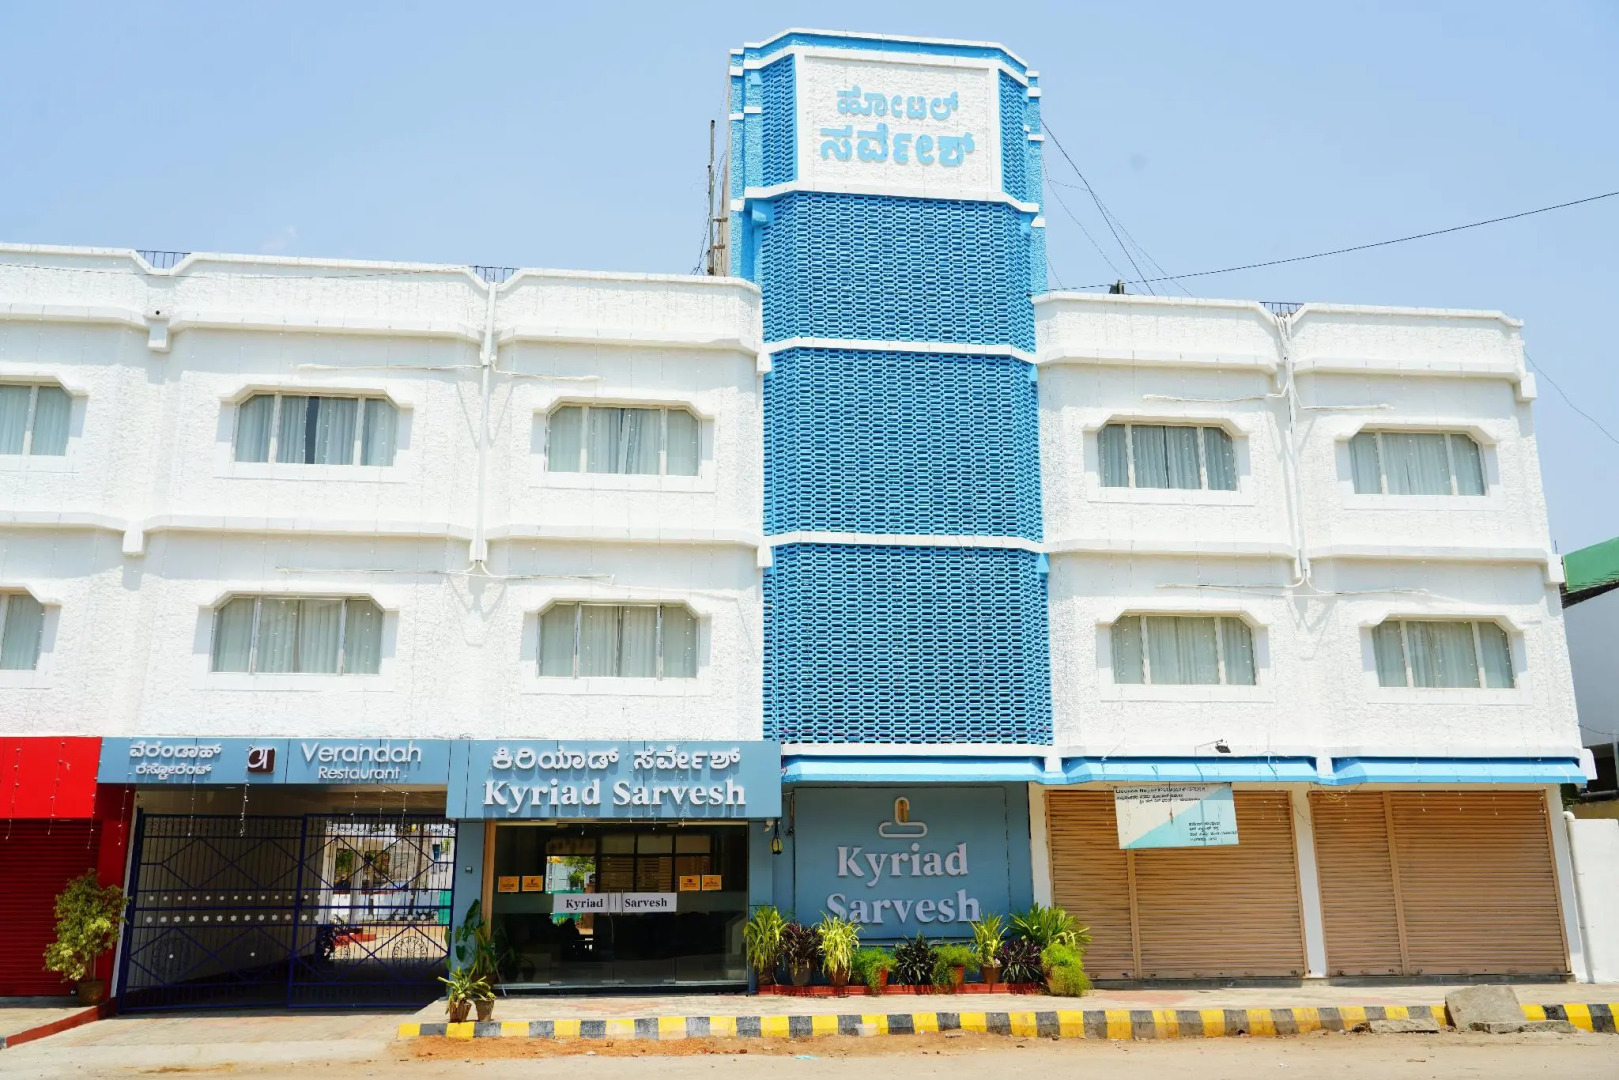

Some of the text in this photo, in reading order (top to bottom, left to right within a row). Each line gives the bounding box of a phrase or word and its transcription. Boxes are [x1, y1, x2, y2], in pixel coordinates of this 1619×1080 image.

[301, 739, 422, 763] Verandah
[492, 744, 741, 770] ಕಿರಿಯಾಡ್ ಸರ್ವೇಶ್
[318, 765, 401, 780] Restaurant
[483, 777, 747, 814] Kyriad Sarvesh
[836, 841, 969, 888] Kyriad
[565, 897, 668, 911] Kyriad Sarvesh
[826, 889, 982, 925] Sarvesh
